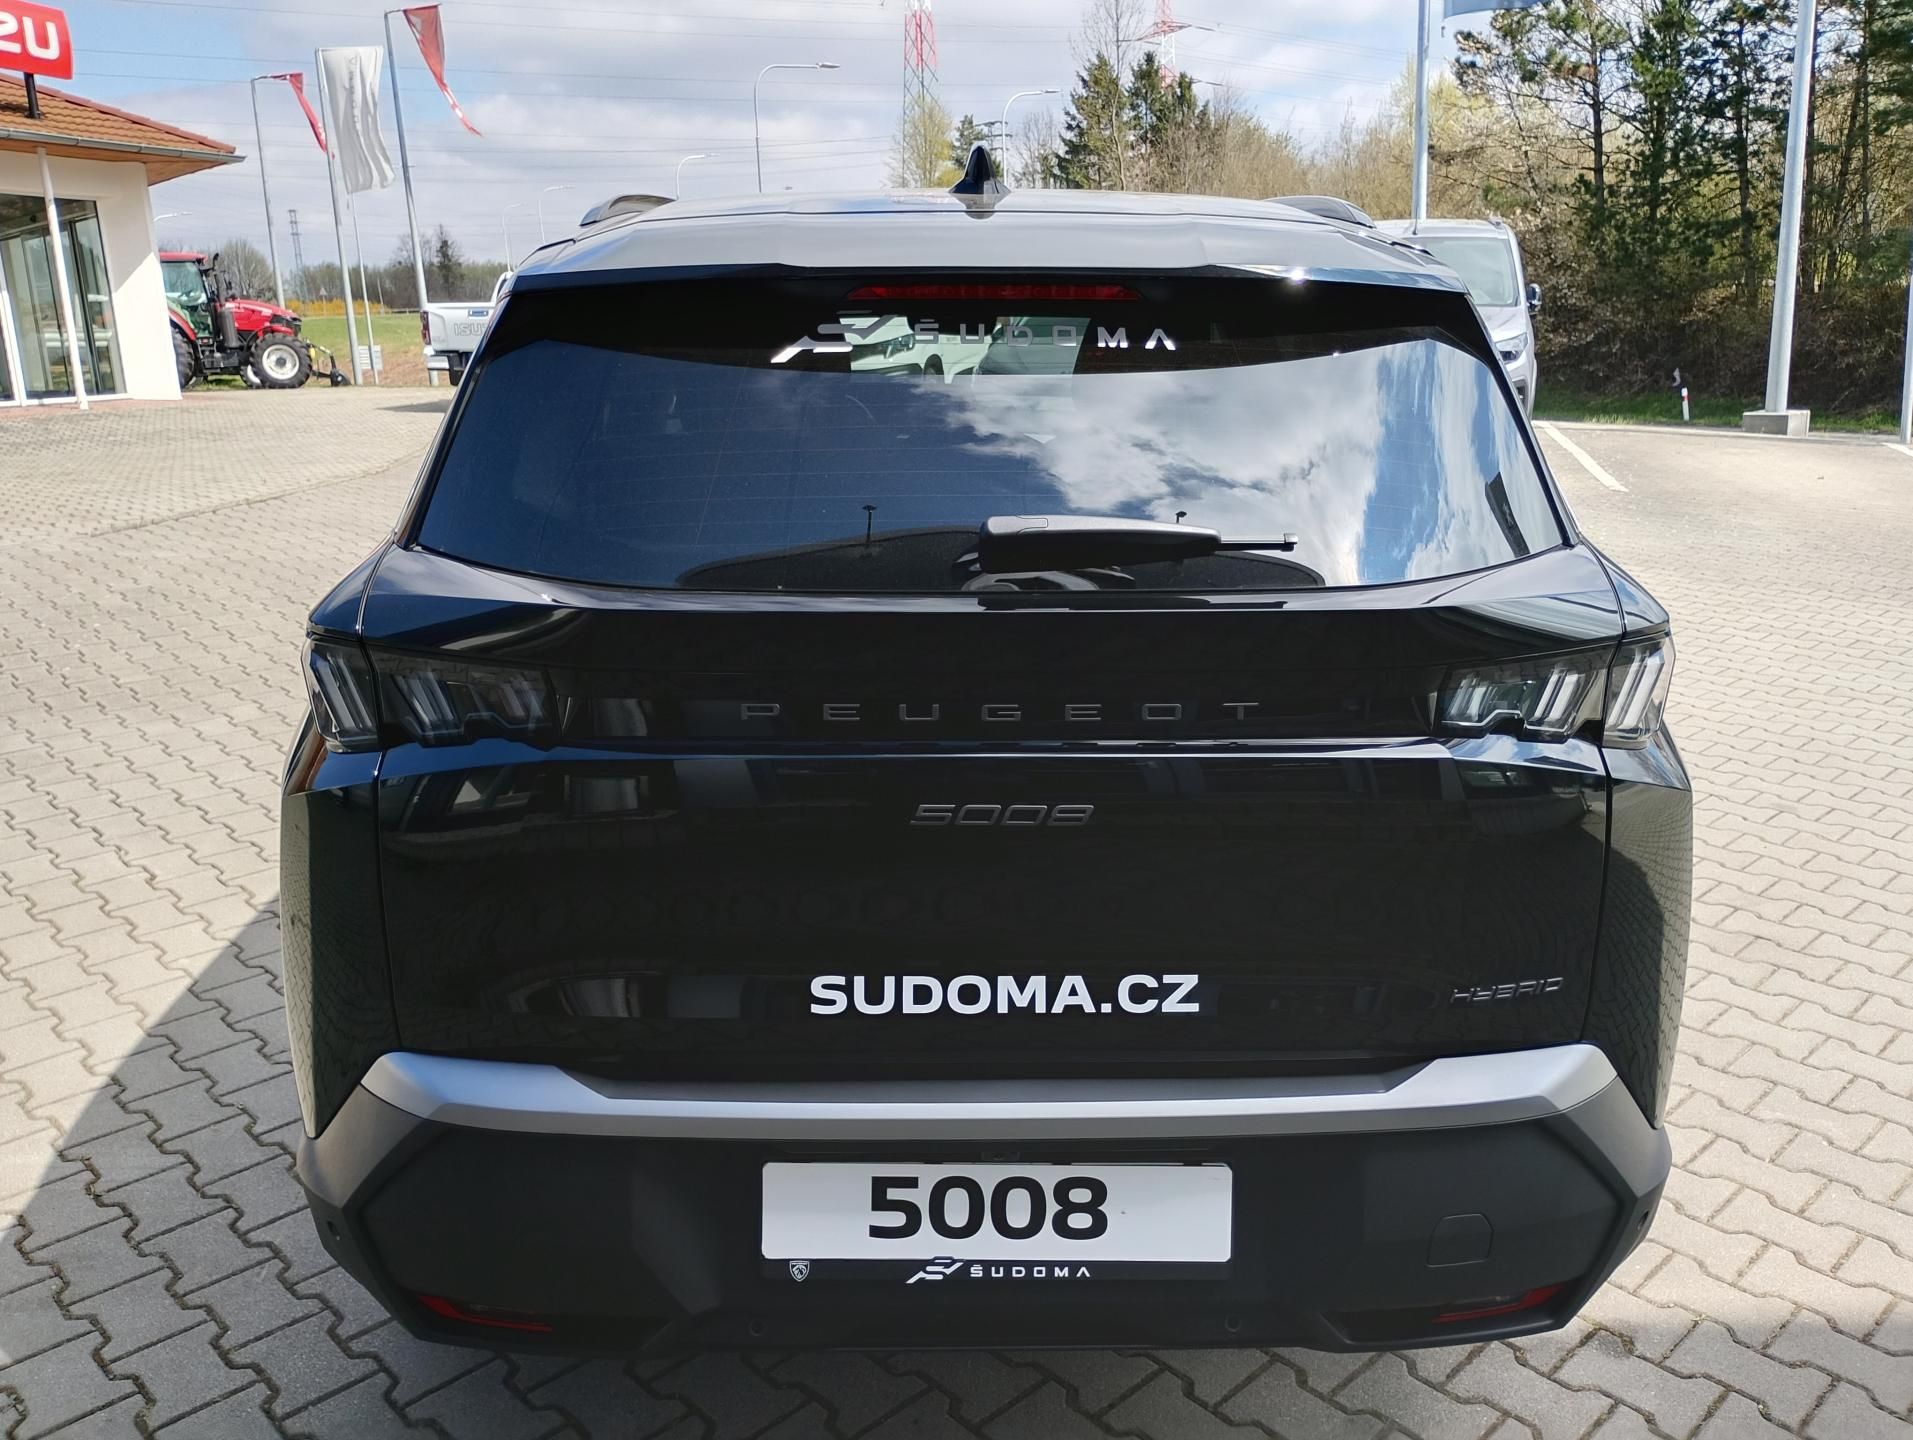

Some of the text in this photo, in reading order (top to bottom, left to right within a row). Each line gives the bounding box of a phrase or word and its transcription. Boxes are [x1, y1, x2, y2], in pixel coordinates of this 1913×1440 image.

[454, 322, 488, 336] ISU
[741, 703, 1260, 720] PEUGEOT
[911, 804, 1095, 826] 5008
[810, 974, 1201, 1015] SUDOMA.CZ
[1450, 976, 1564, 1003] HYBRID
[868, 1175, 1109, 1240] 5008
